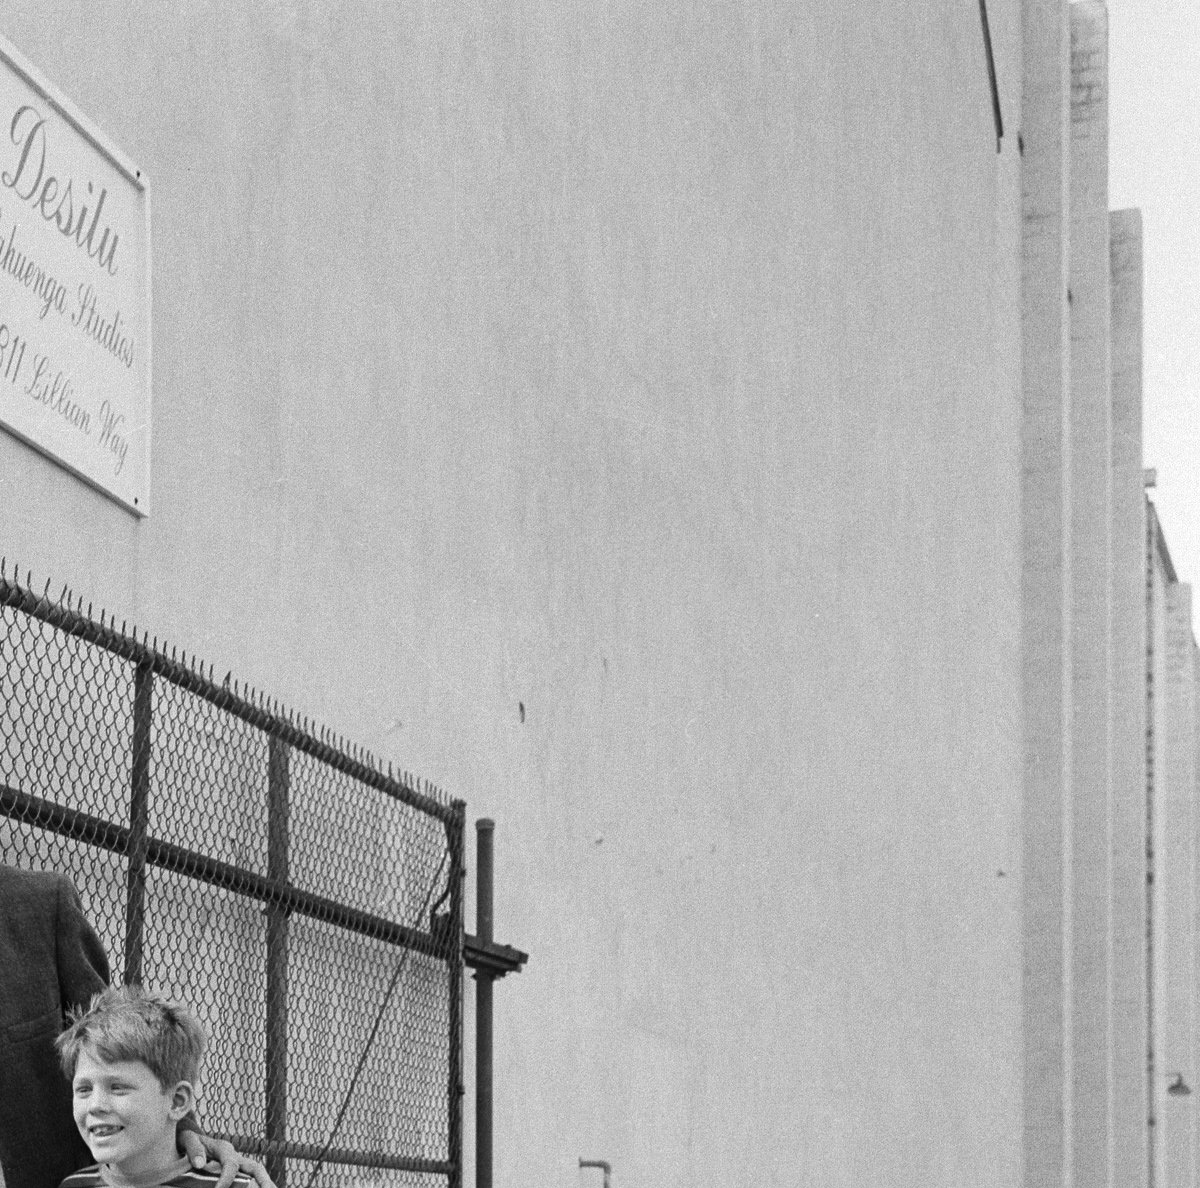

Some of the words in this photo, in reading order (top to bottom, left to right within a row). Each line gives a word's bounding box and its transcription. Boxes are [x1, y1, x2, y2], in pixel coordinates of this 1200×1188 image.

[1, 105, 119, 276] Desilu
[72, 283, 134, 369] Studios
[24, 354, 90, 436] Lillian
[100, 400, 129, 476] Way
